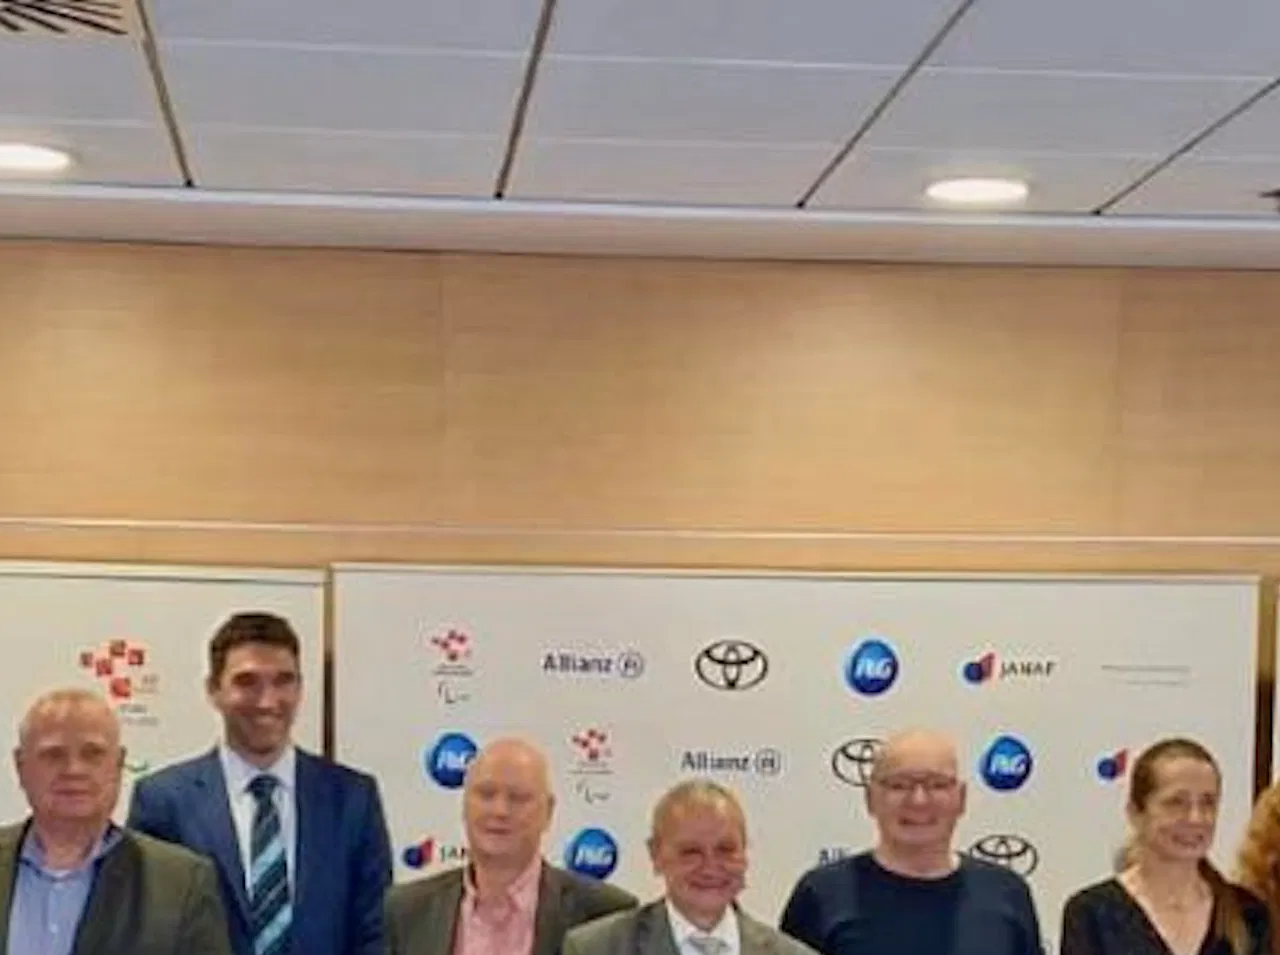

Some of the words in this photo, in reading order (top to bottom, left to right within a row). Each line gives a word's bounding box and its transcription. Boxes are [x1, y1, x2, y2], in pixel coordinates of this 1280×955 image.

[543, 653, 613, 673] Allianz
[855, 658, 894, 680] P&G
[1001, 661, 1056, 678] JANAF
[682, 751, 750, 771] Allianz
[989, 753, 1029, 776] P&G
[574, 847, 613, 870] P&G
